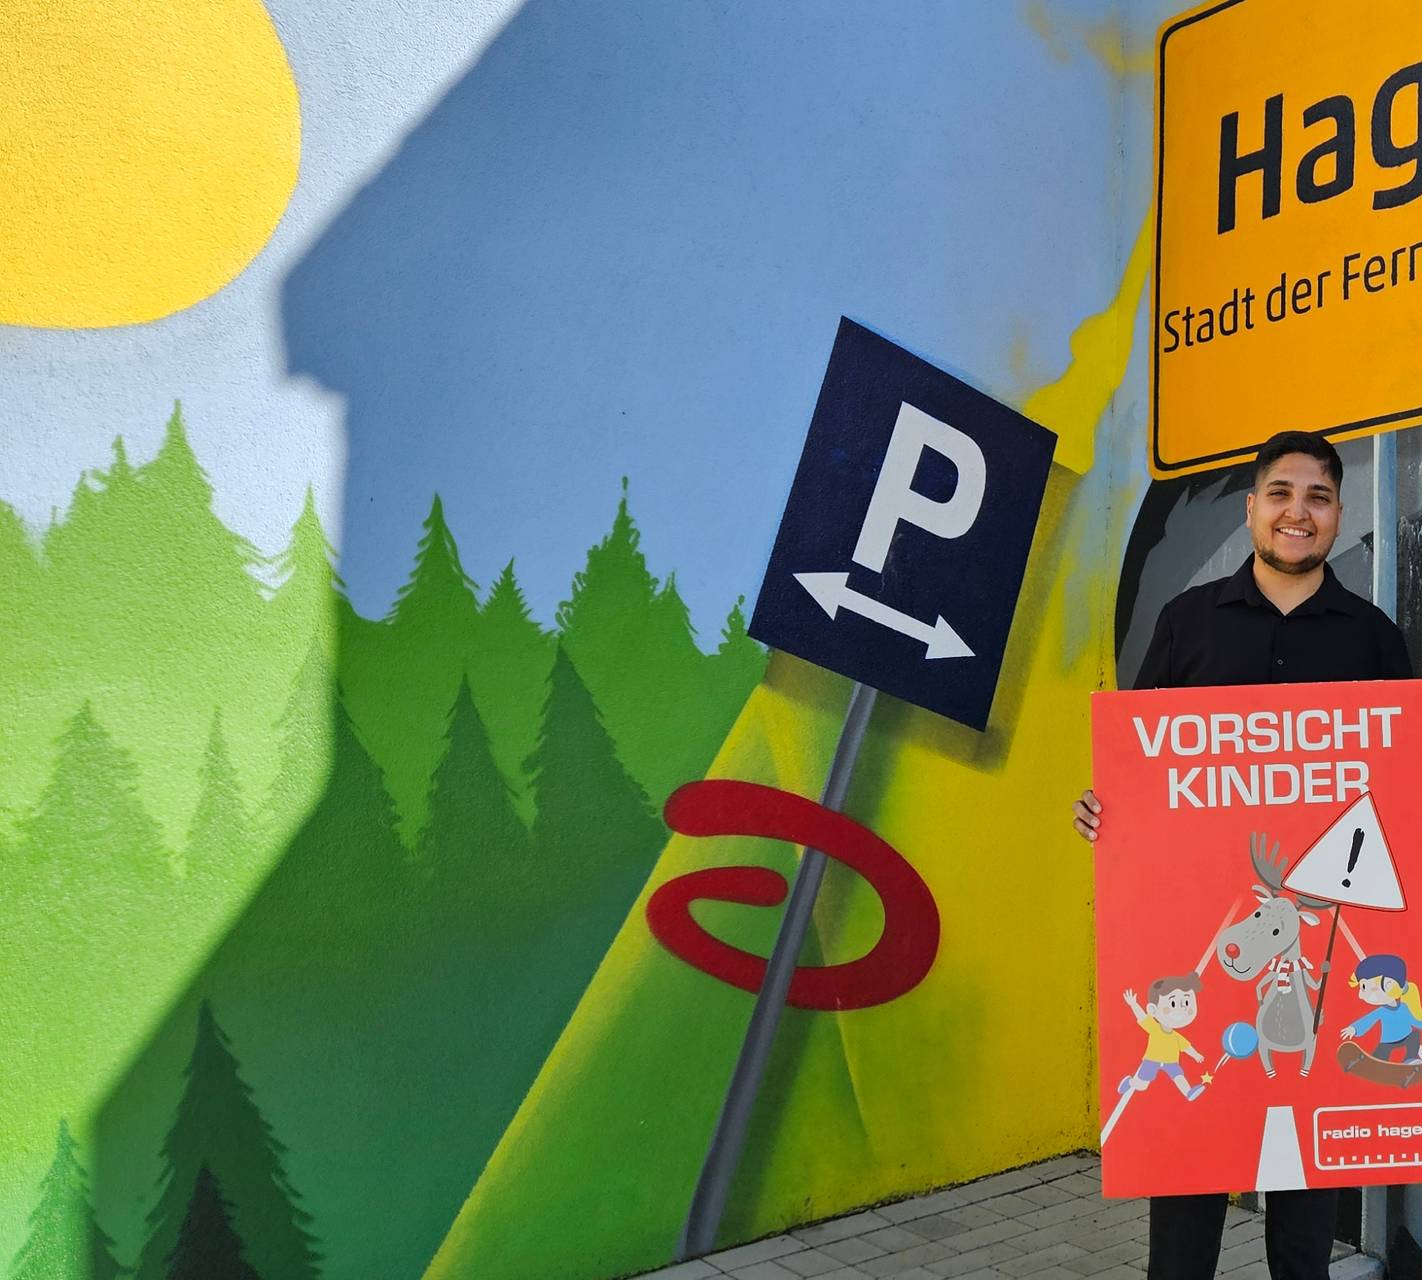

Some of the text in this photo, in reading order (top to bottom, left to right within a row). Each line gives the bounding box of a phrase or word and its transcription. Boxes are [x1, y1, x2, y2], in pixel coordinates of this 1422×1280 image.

[1163, 287, 1256, 354] Stadt
[1266, 271, 1331, 323] der
[851, 400, 987, 574] P
[1132, 706, 1402, 758] VORSICHT
[1167, 760, 1371, 809] KINDER
[1322, 1125, 1371, 1140] radio
